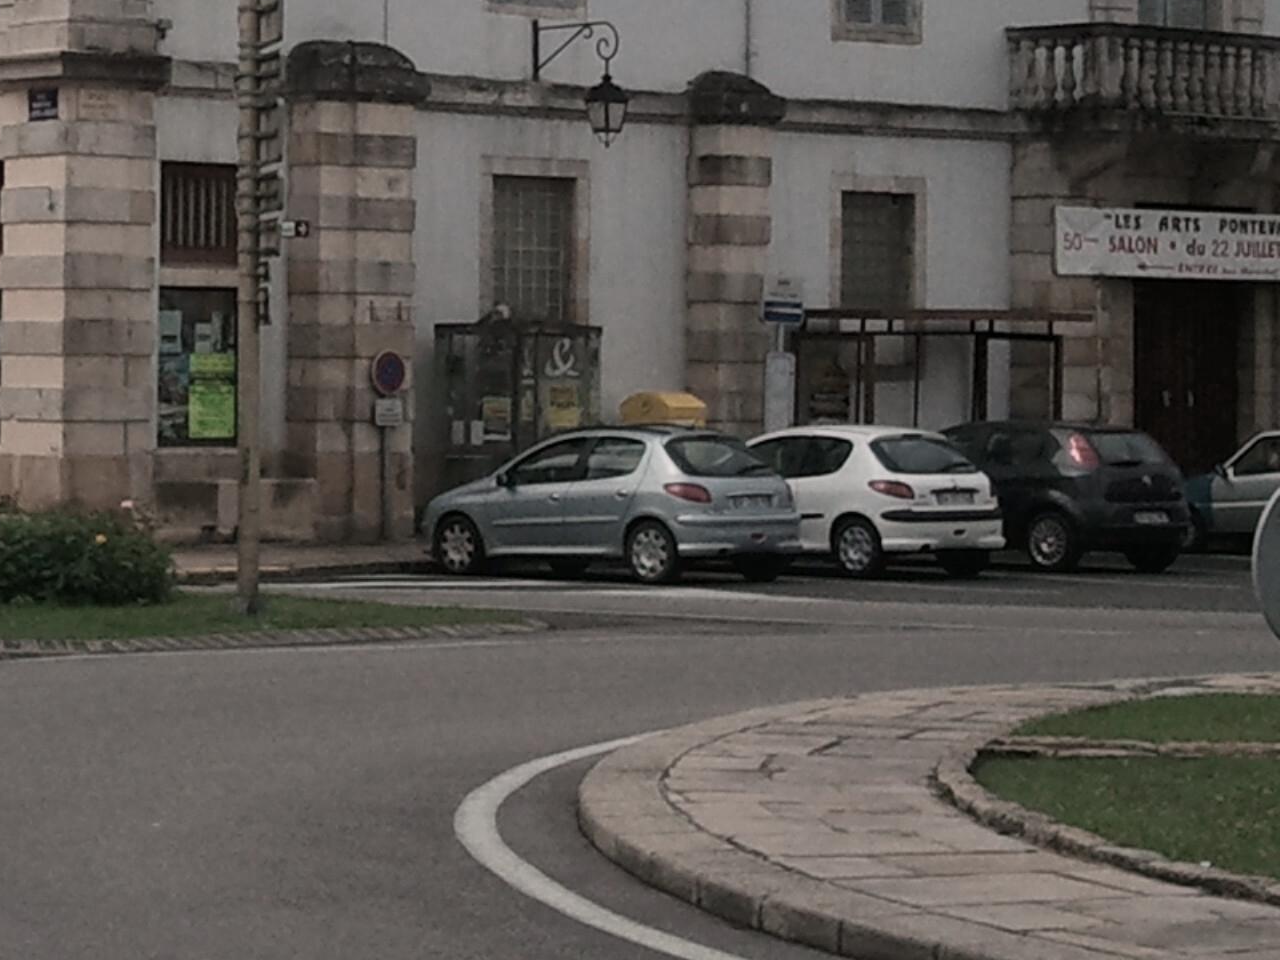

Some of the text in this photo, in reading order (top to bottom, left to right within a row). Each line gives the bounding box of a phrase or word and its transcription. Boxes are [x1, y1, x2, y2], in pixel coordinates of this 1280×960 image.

[1159, 216, 1201, 233] ARTS
[1108, 236, 1158, 254] SALON
[1185, 238, 1206, 257] du
[1211, 239, 1229, 258] 22
